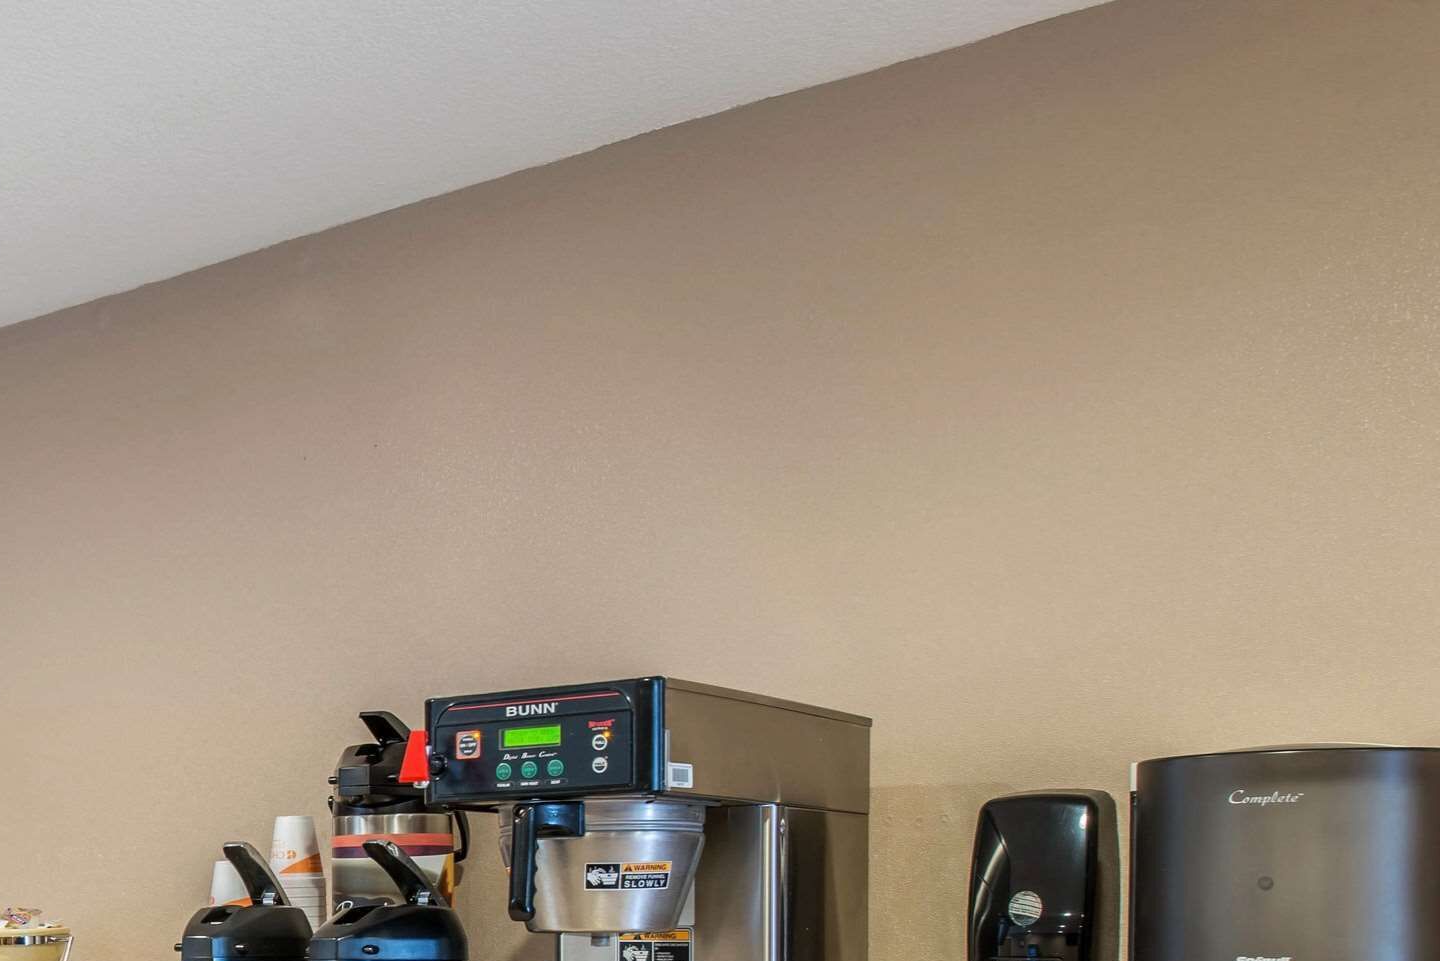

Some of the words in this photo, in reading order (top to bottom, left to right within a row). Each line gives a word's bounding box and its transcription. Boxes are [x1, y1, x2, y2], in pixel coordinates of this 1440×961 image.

[506, 703, 556, 717] BUNN
[1229, 789, 1300, 806] Complete
[633, 863, 667, 871] WARNING
[623, 880, 665, 888] SLOWLY
